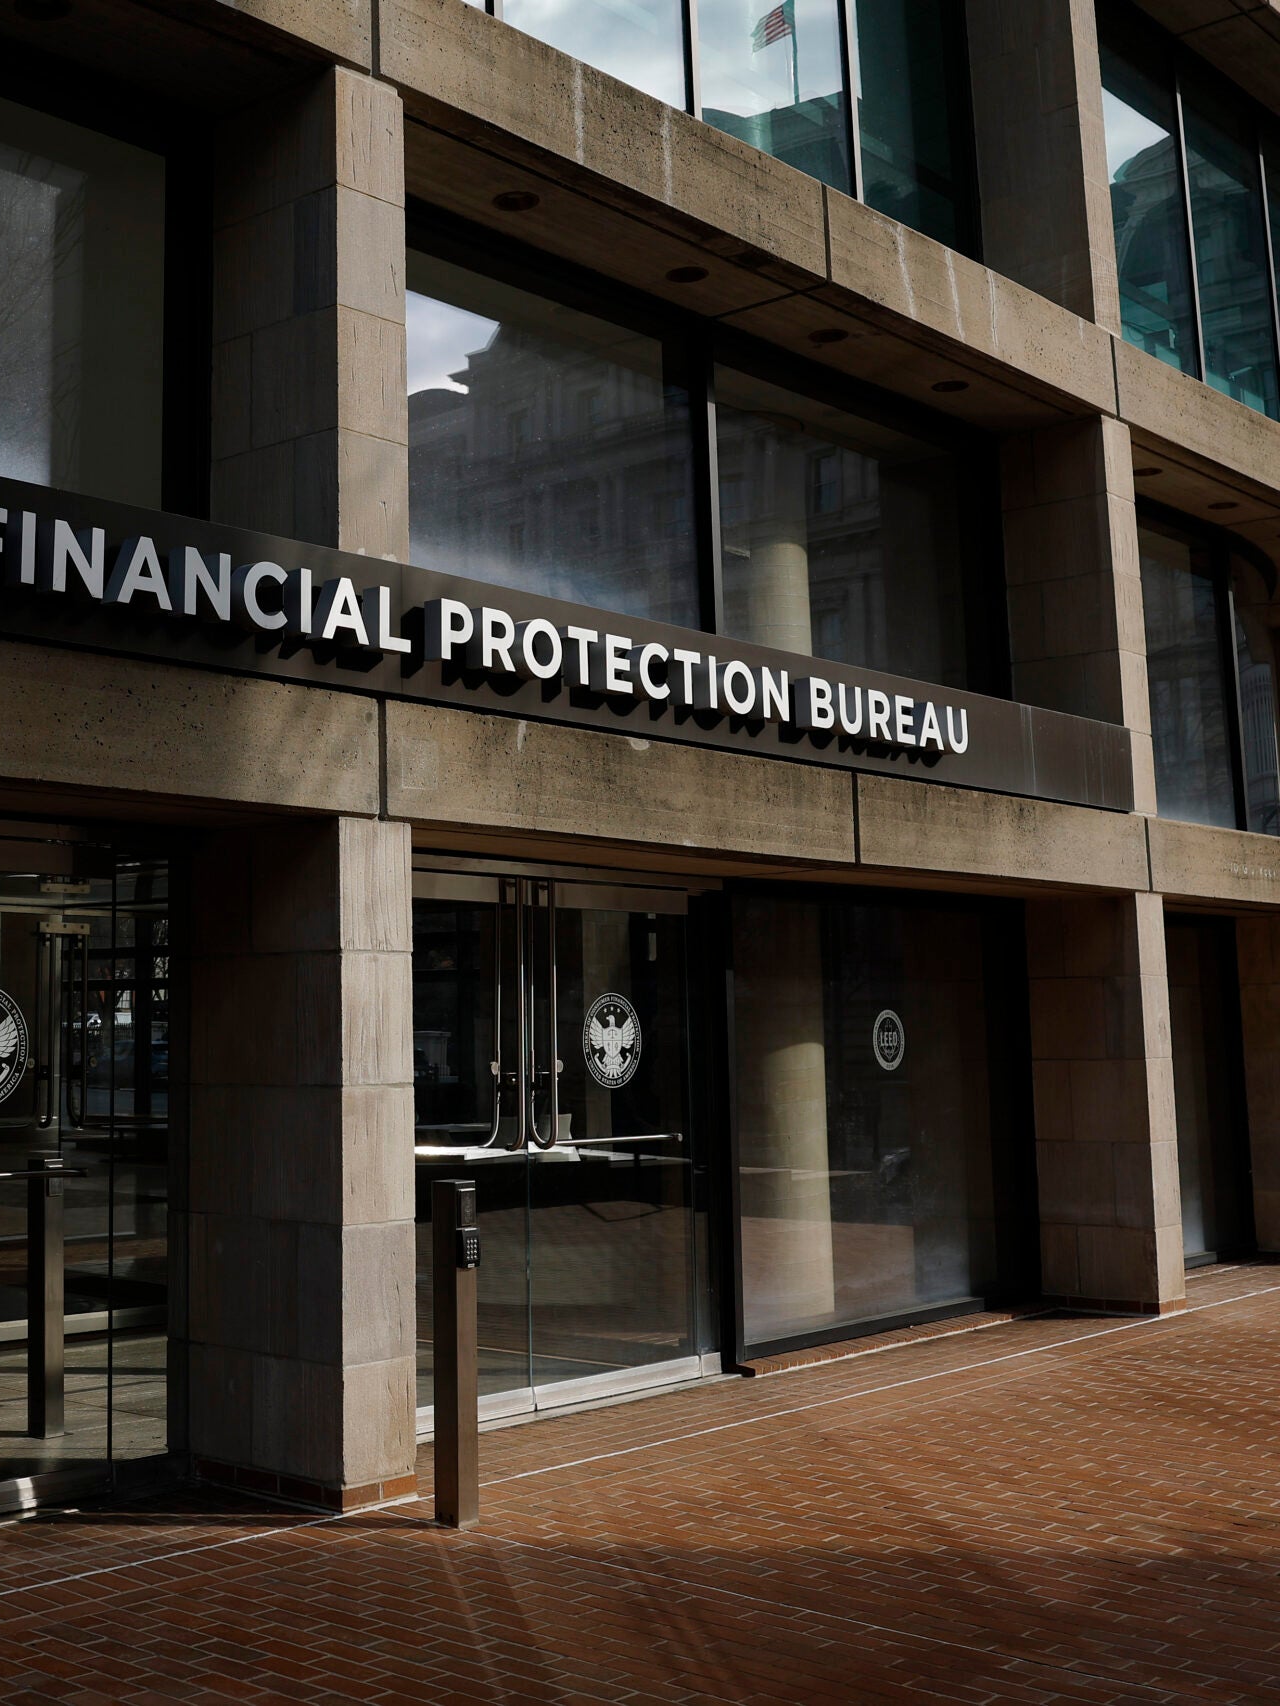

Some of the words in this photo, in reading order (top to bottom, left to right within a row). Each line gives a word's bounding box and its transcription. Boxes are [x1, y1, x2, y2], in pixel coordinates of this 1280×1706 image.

[440, 597, 790, 722] PROTECTION
[809, 676, 970, 754] BUREAU
[11, 1009, 27, 1063] PROTECTION
[880, 1031, 898, 1047] LEED
